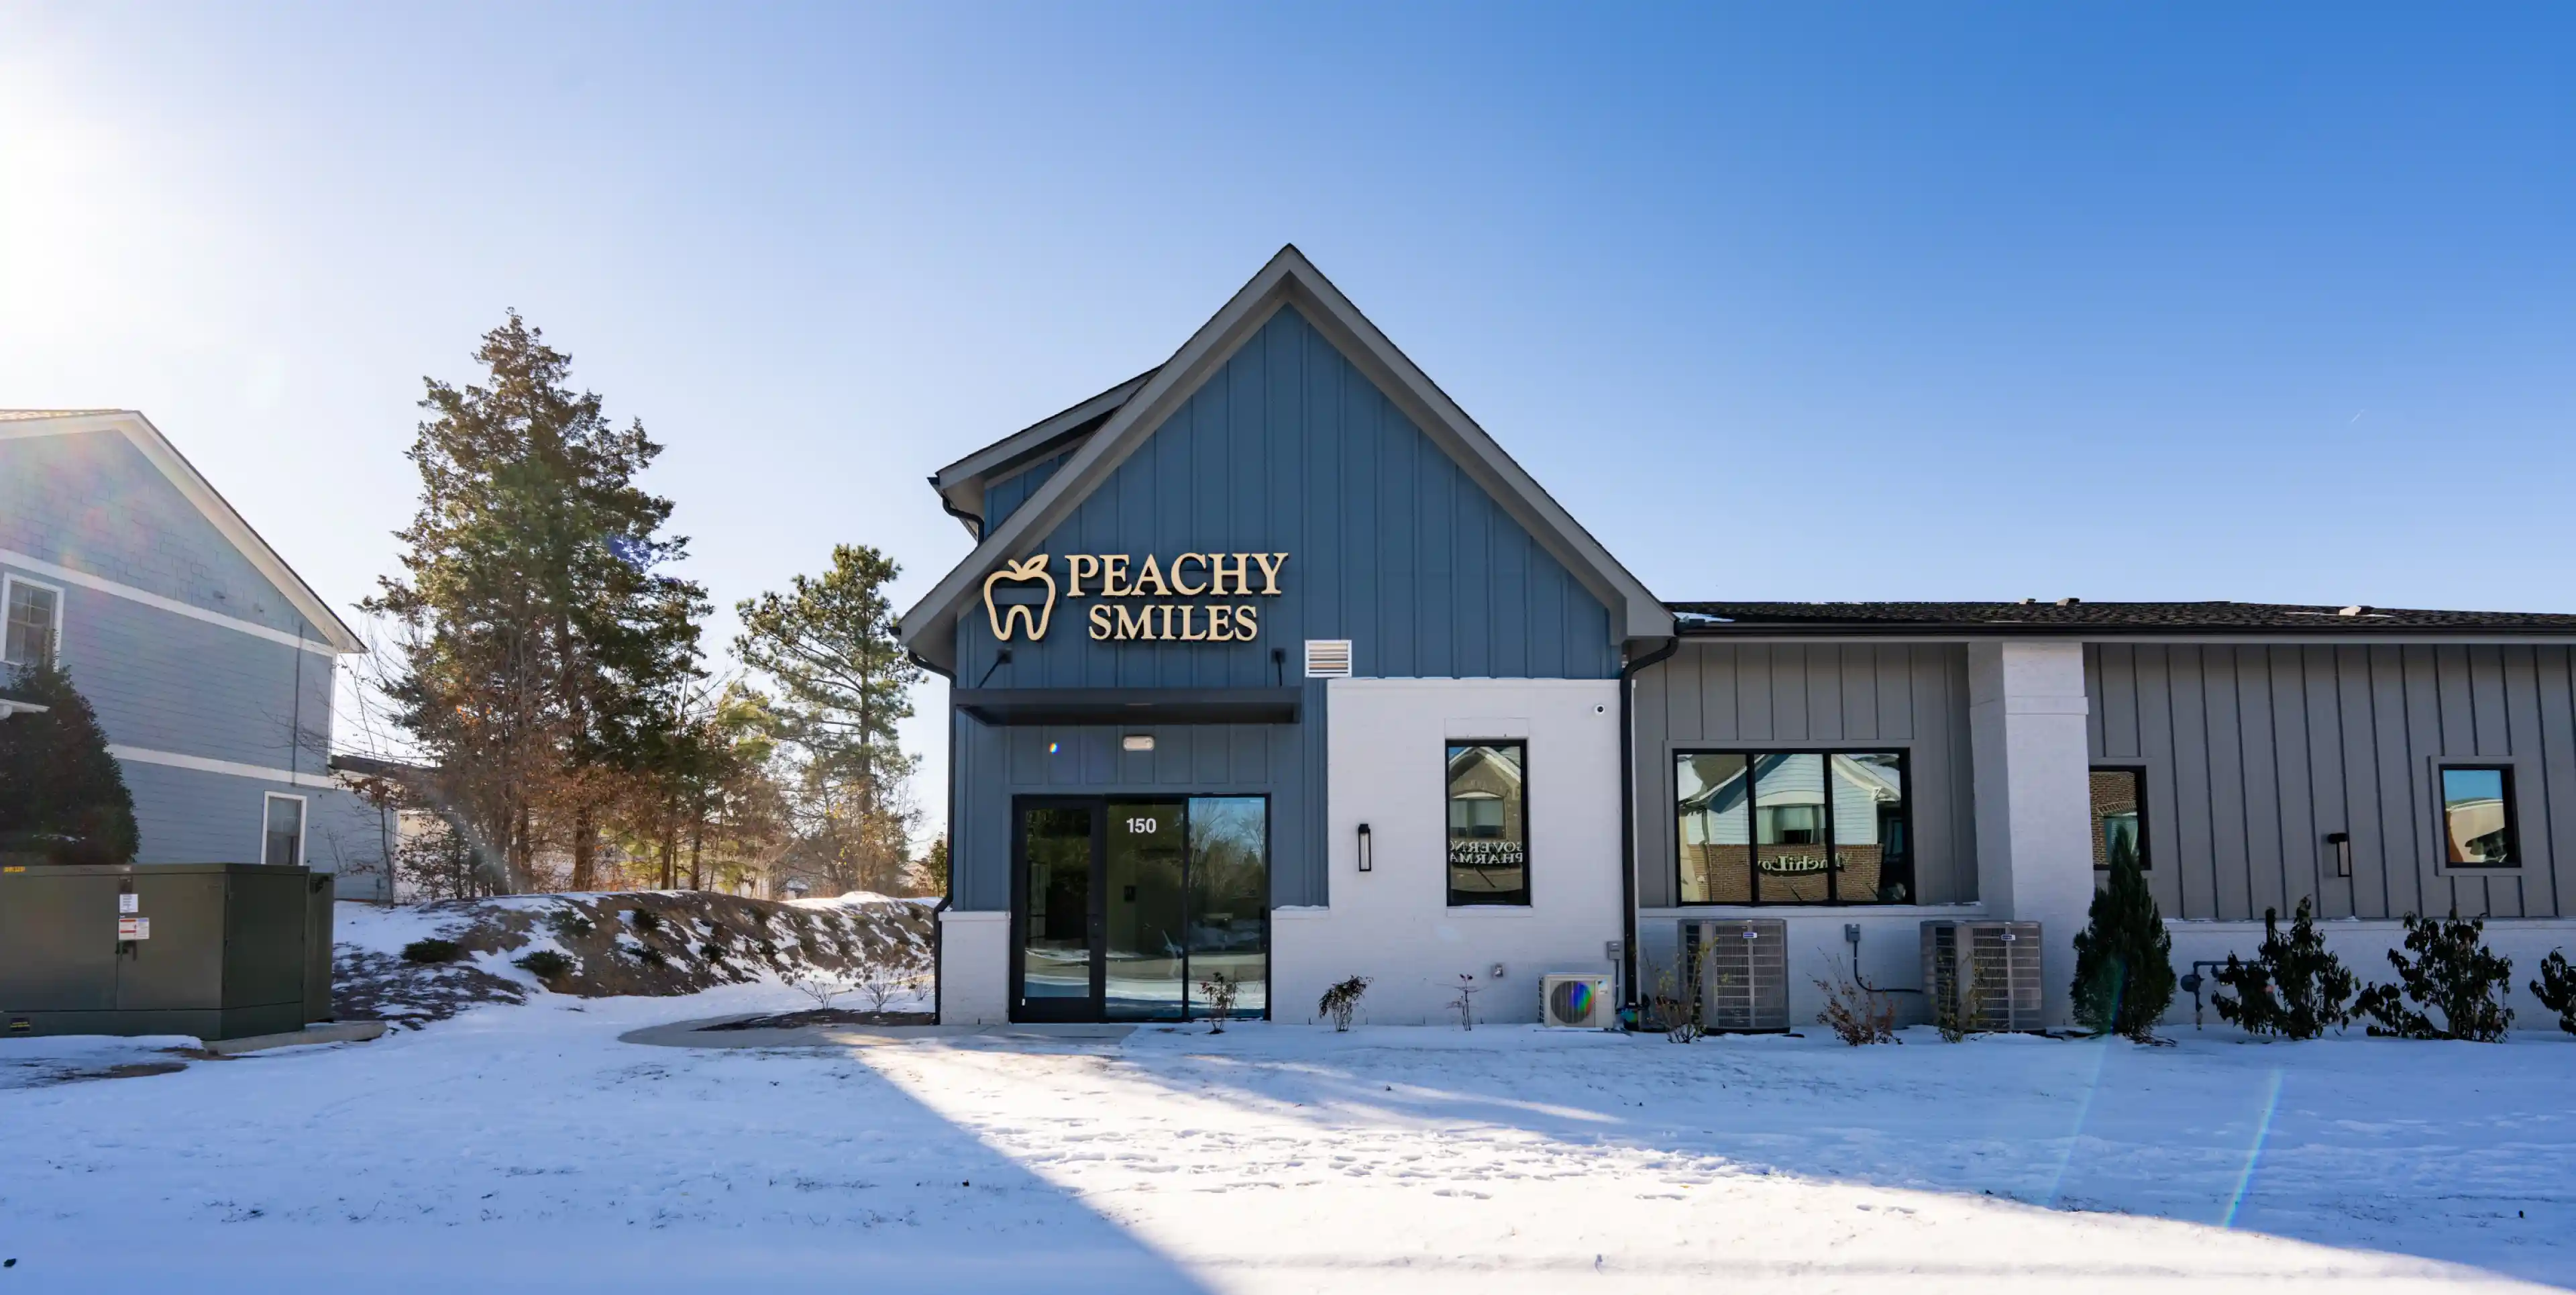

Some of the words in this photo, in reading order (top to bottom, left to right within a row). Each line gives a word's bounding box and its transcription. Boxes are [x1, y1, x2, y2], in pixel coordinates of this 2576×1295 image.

[1065, 553, 1289, 597] PEACHY
[1088, 604, 1258, 641] SMILES
[1126, 818, 1157, 833] 150
